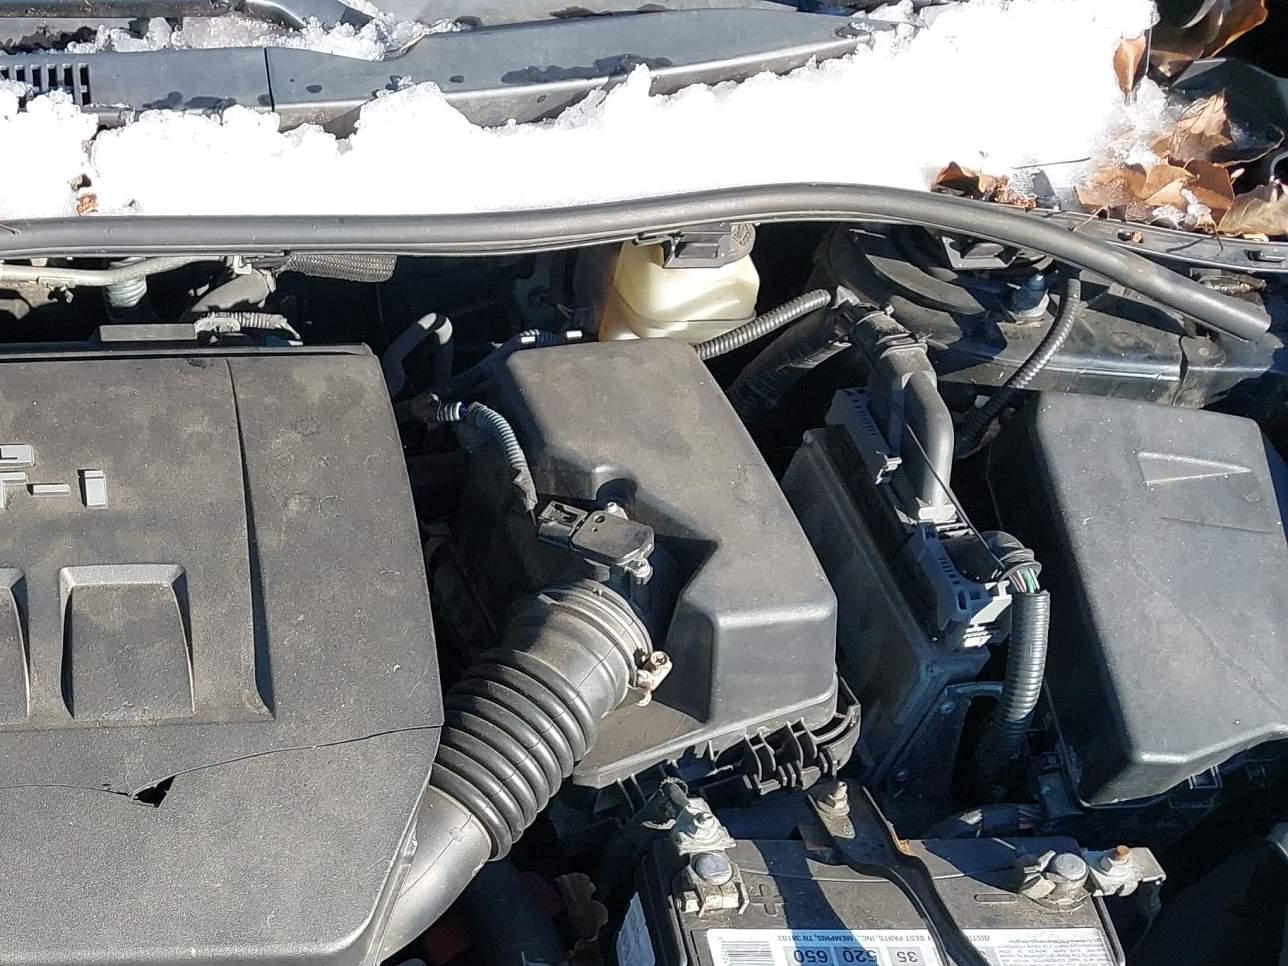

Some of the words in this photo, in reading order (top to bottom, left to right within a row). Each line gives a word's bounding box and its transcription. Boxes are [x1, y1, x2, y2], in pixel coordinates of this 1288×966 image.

[793, 949, 829, 963] 650
[842, 949, 878, 963] 520
[896, 951, 918, 963] 35
